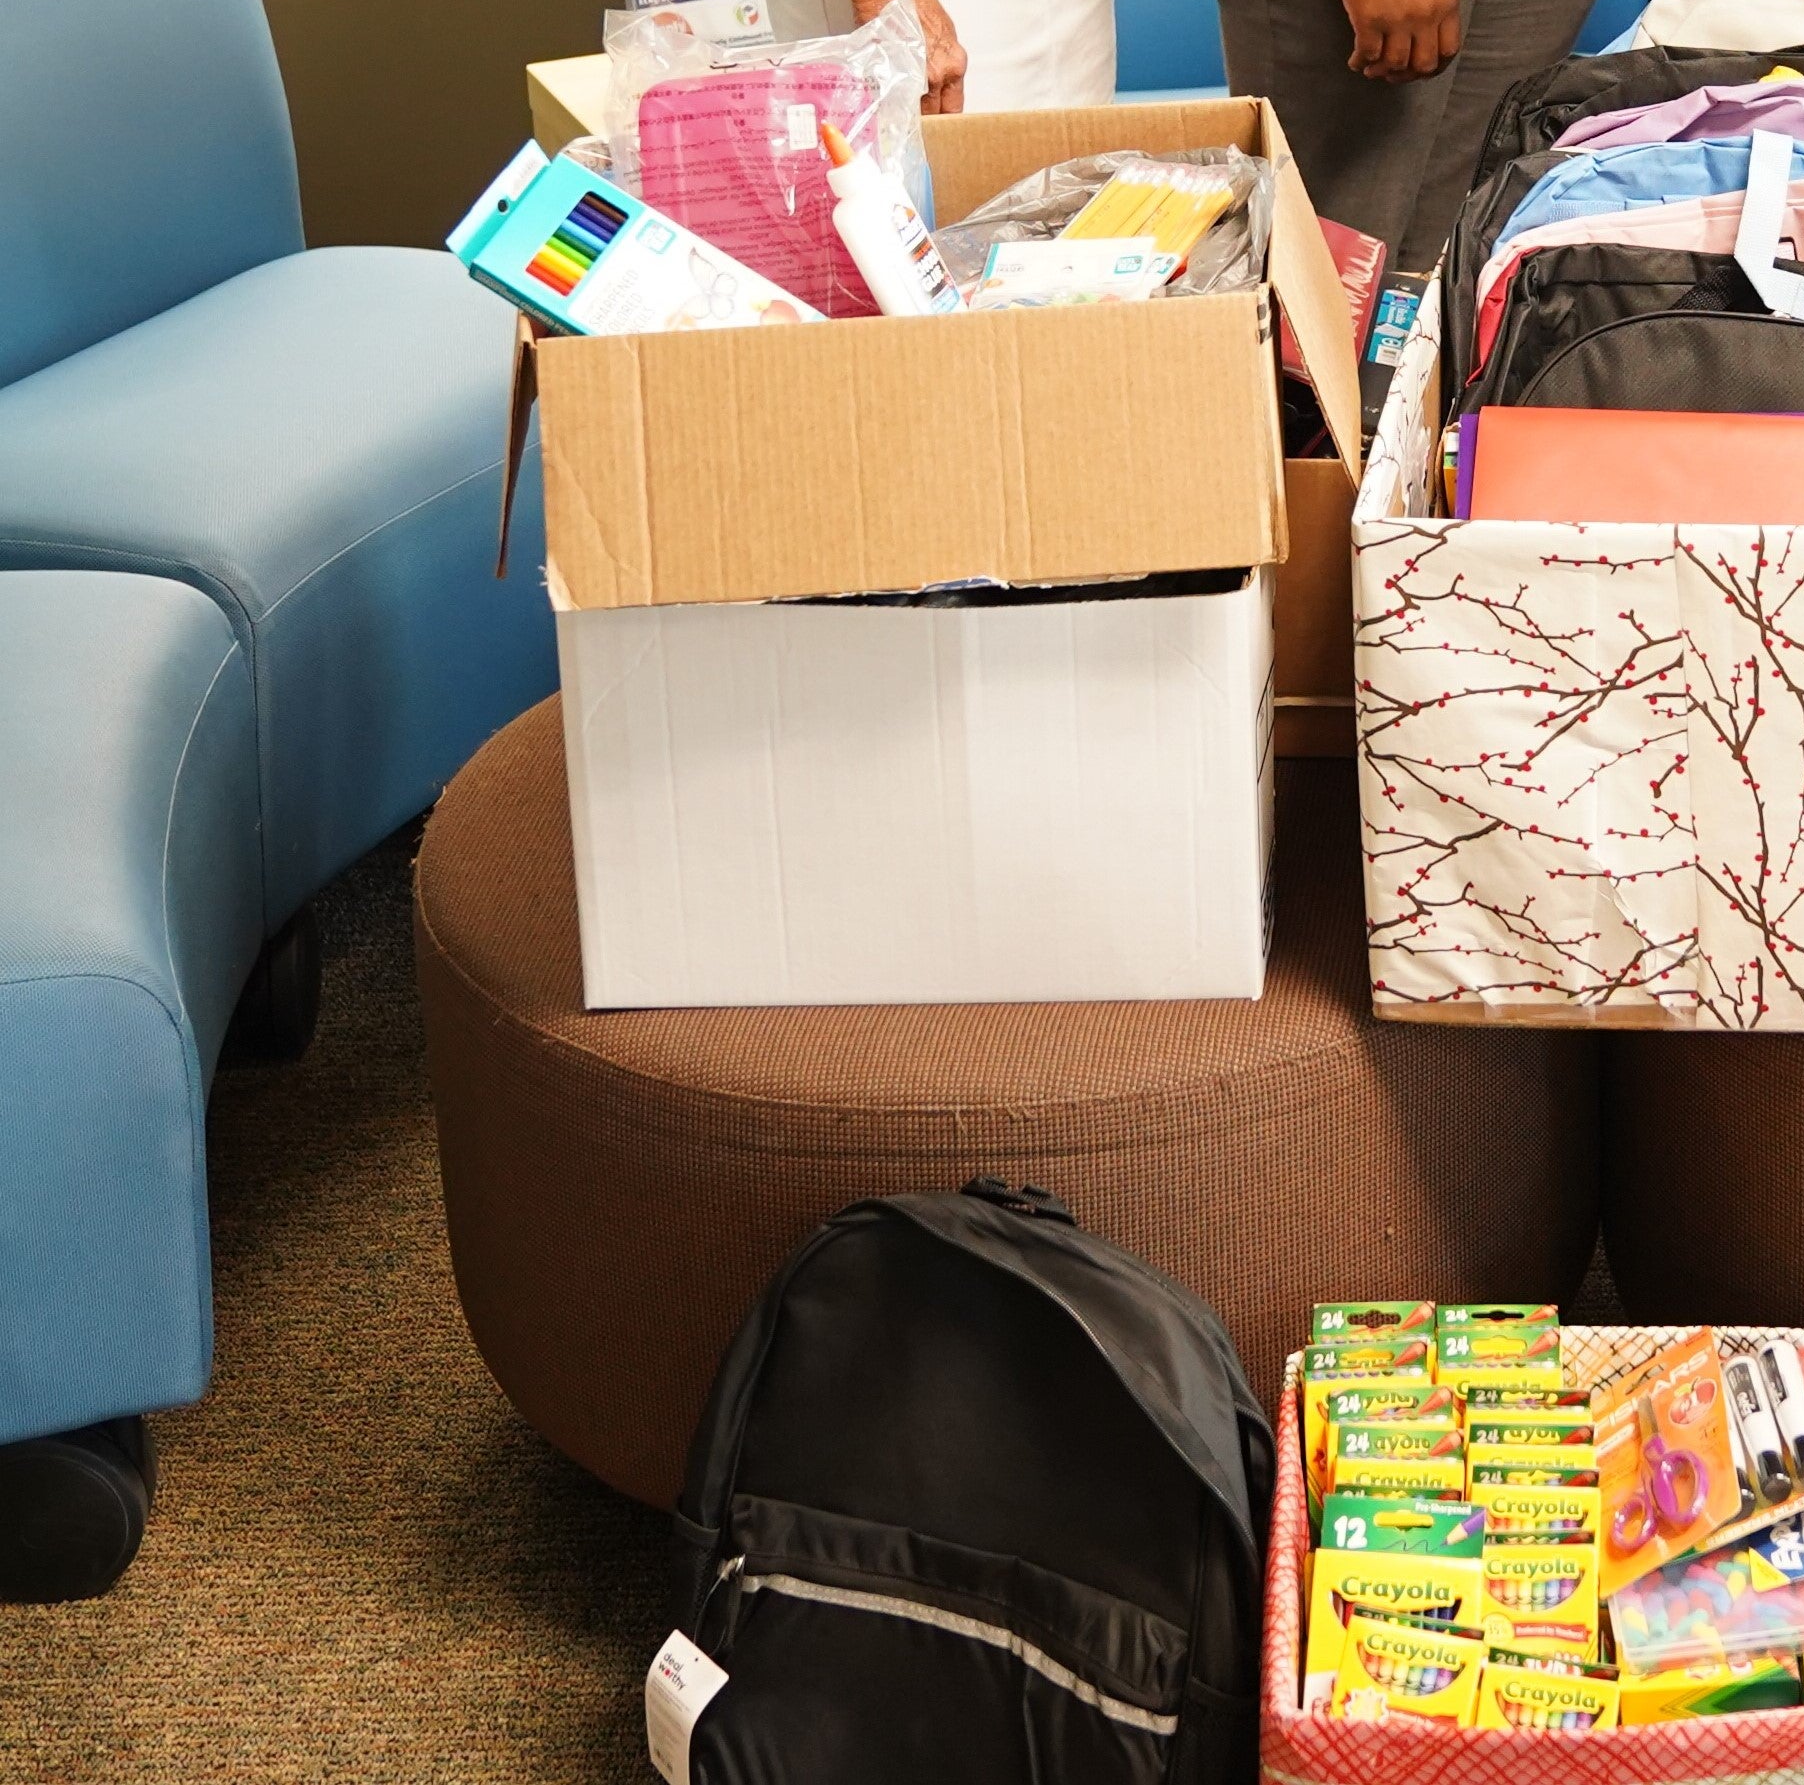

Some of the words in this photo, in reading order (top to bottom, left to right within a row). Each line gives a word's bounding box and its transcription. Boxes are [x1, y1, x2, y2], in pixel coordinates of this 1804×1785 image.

[1321, 1310, 1345, 1330] 24
[1445, 1308, 1468, 1322] 24
[1446, 1335, 1469, 1356] 24
[1313, 1351, 1337, 1369] 24
[1337, 1393, 1361, 1414] 24
[1475, 1390, 1498, 1403] 24
[1345, 1432, 1370, 1453] 24
[1476, 1429, 1500, 1444] 24
[1480, 1470, 1503, 1484] 24
[1491, 1495, 1581, 1518] Crayola
[1334, 1515, 1368, 1549] 12
[1487, 1557, 1576, 1578] Crayola
[1341, 1576, 1450, 1603] Crayola
[1366, 1632, 1457, 1665] Crayola
[663, 1651, 684, 1672] deal
[1504, 1681, 1596, 1709] Crayola
